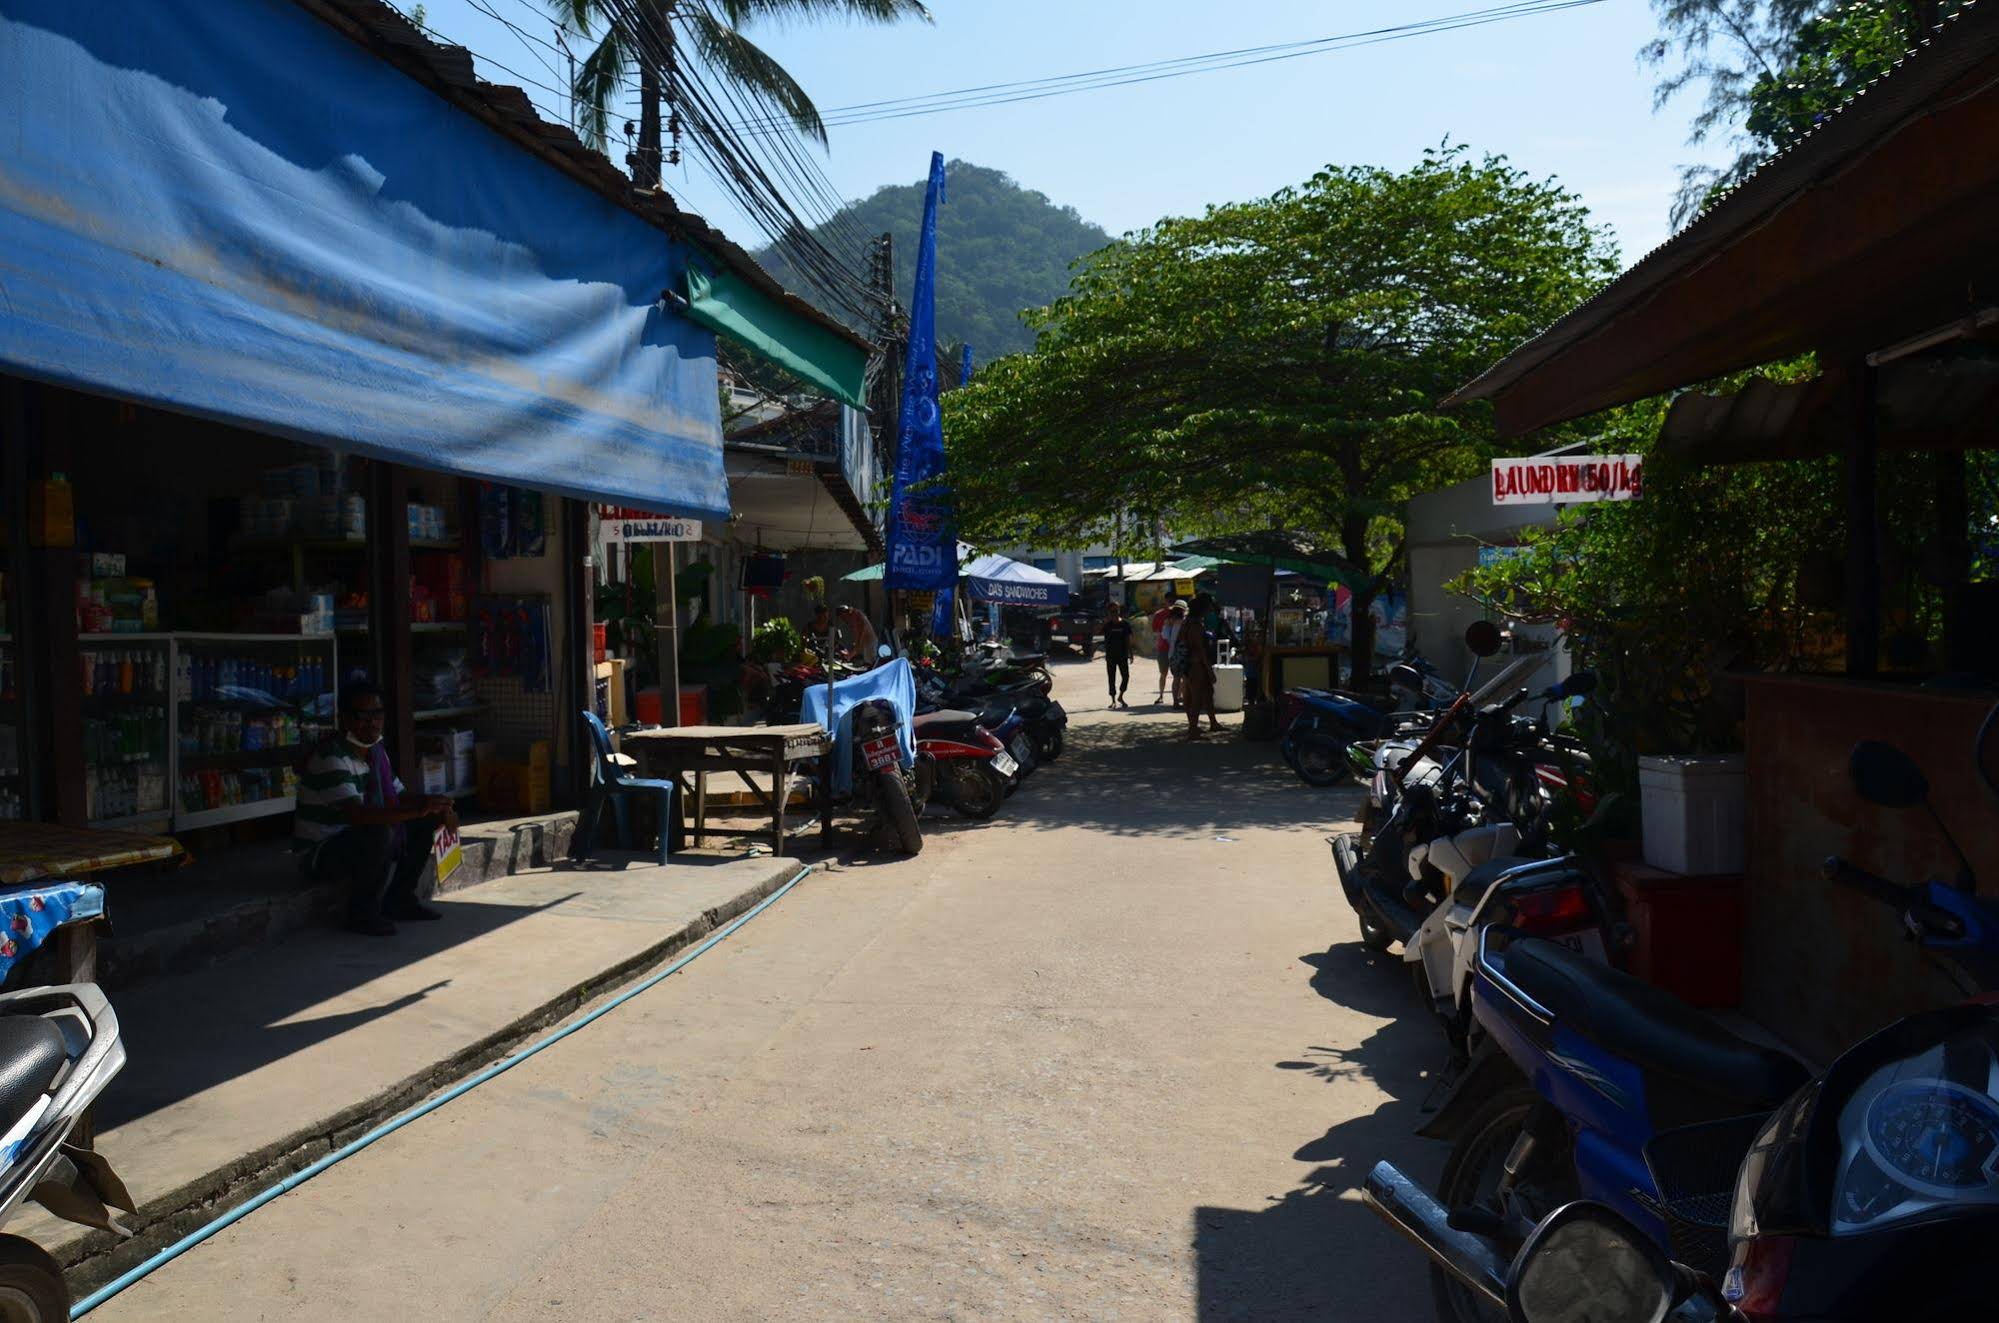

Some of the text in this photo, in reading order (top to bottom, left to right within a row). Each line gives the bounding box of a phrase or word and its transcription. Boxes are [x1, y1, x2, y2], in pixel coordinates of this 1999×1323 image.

[1494, 464, 1580, 496] LAUNDRY
[893, 543, 943, 566] PADI
[892, 566, 943, 577] padi.com
[1004, 585, 1048, 600] SANDWICHES
[435, 829, 458, 858] TAXI
